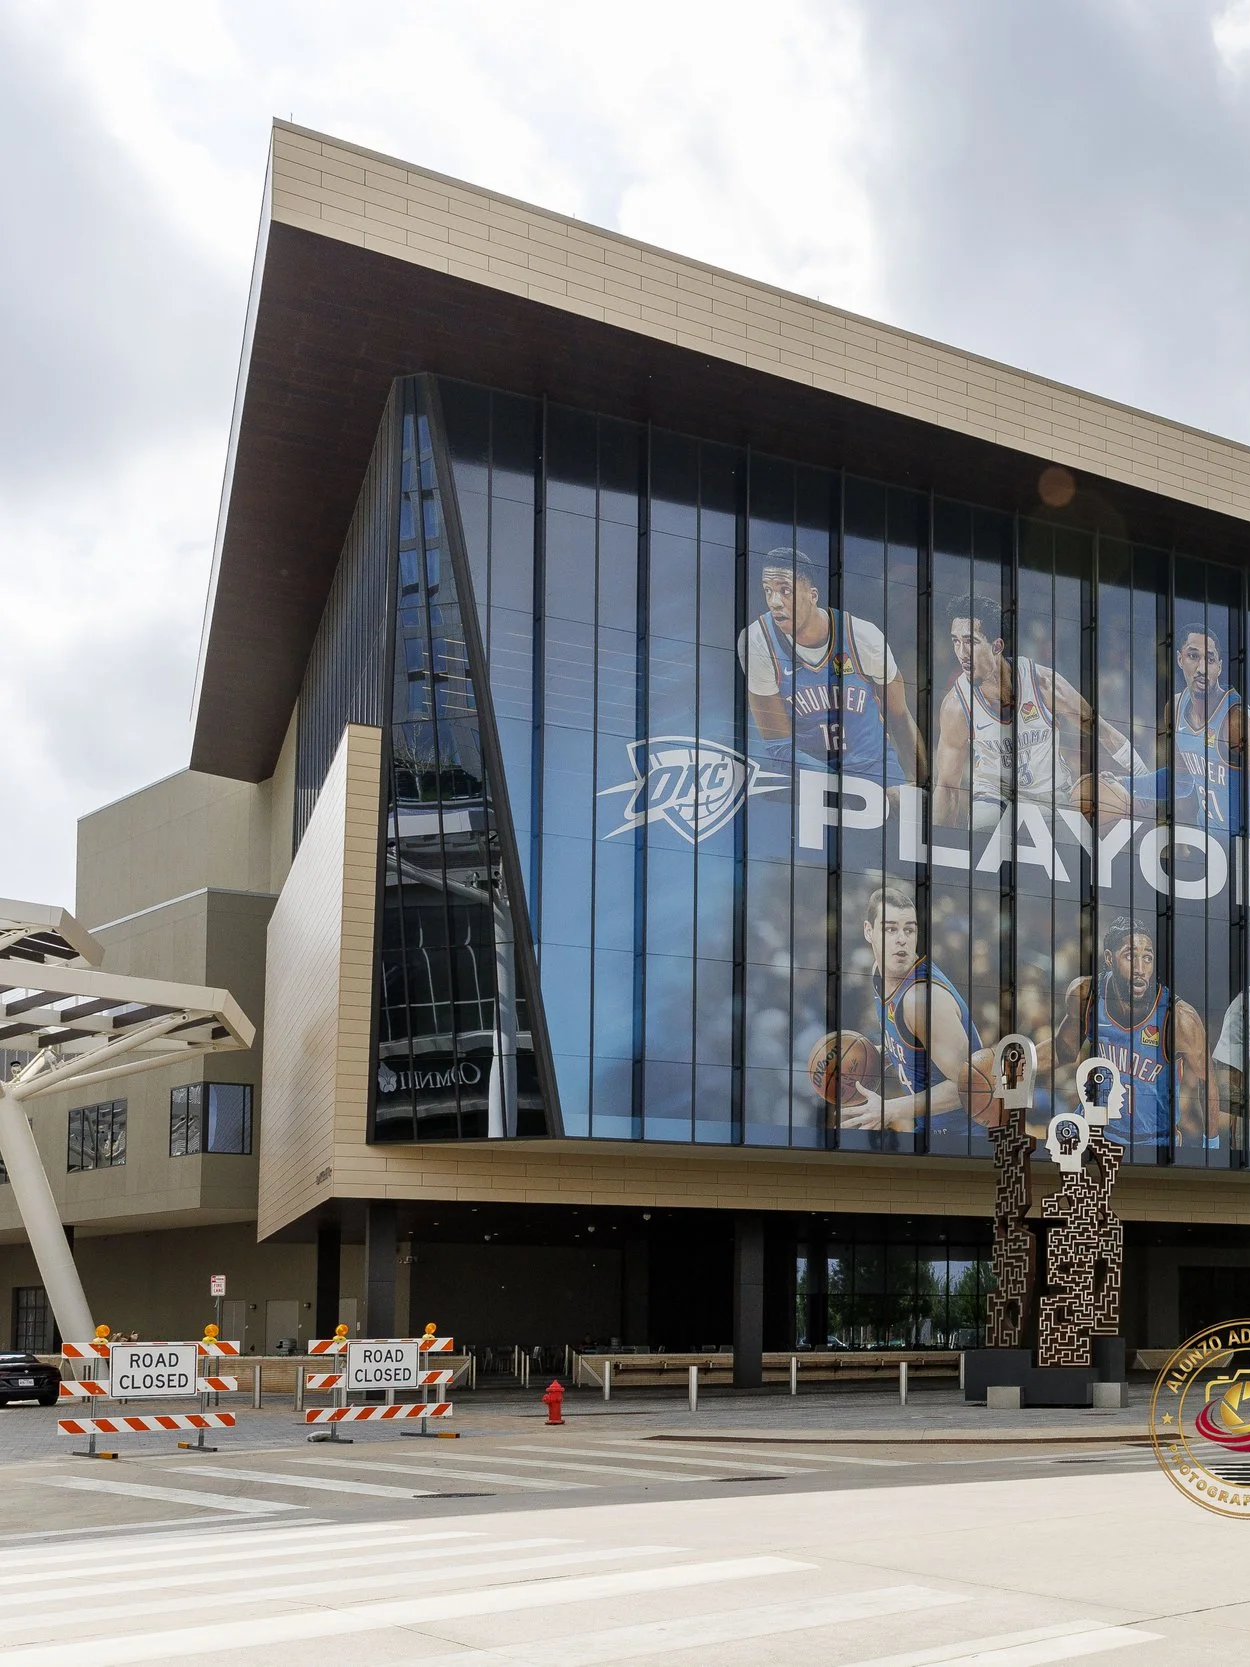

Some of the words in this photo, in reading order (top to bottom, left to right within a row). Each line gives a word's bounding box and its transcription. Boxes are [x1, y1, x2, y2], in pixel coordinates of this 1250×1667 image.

[130, 1353, 179, 1368] ROAD
[363, 1349, 404, 1363] ROAD
[119, 1373, 188, 1389] CLOSED
[354, 1367, 412, 1383] CLOSED
